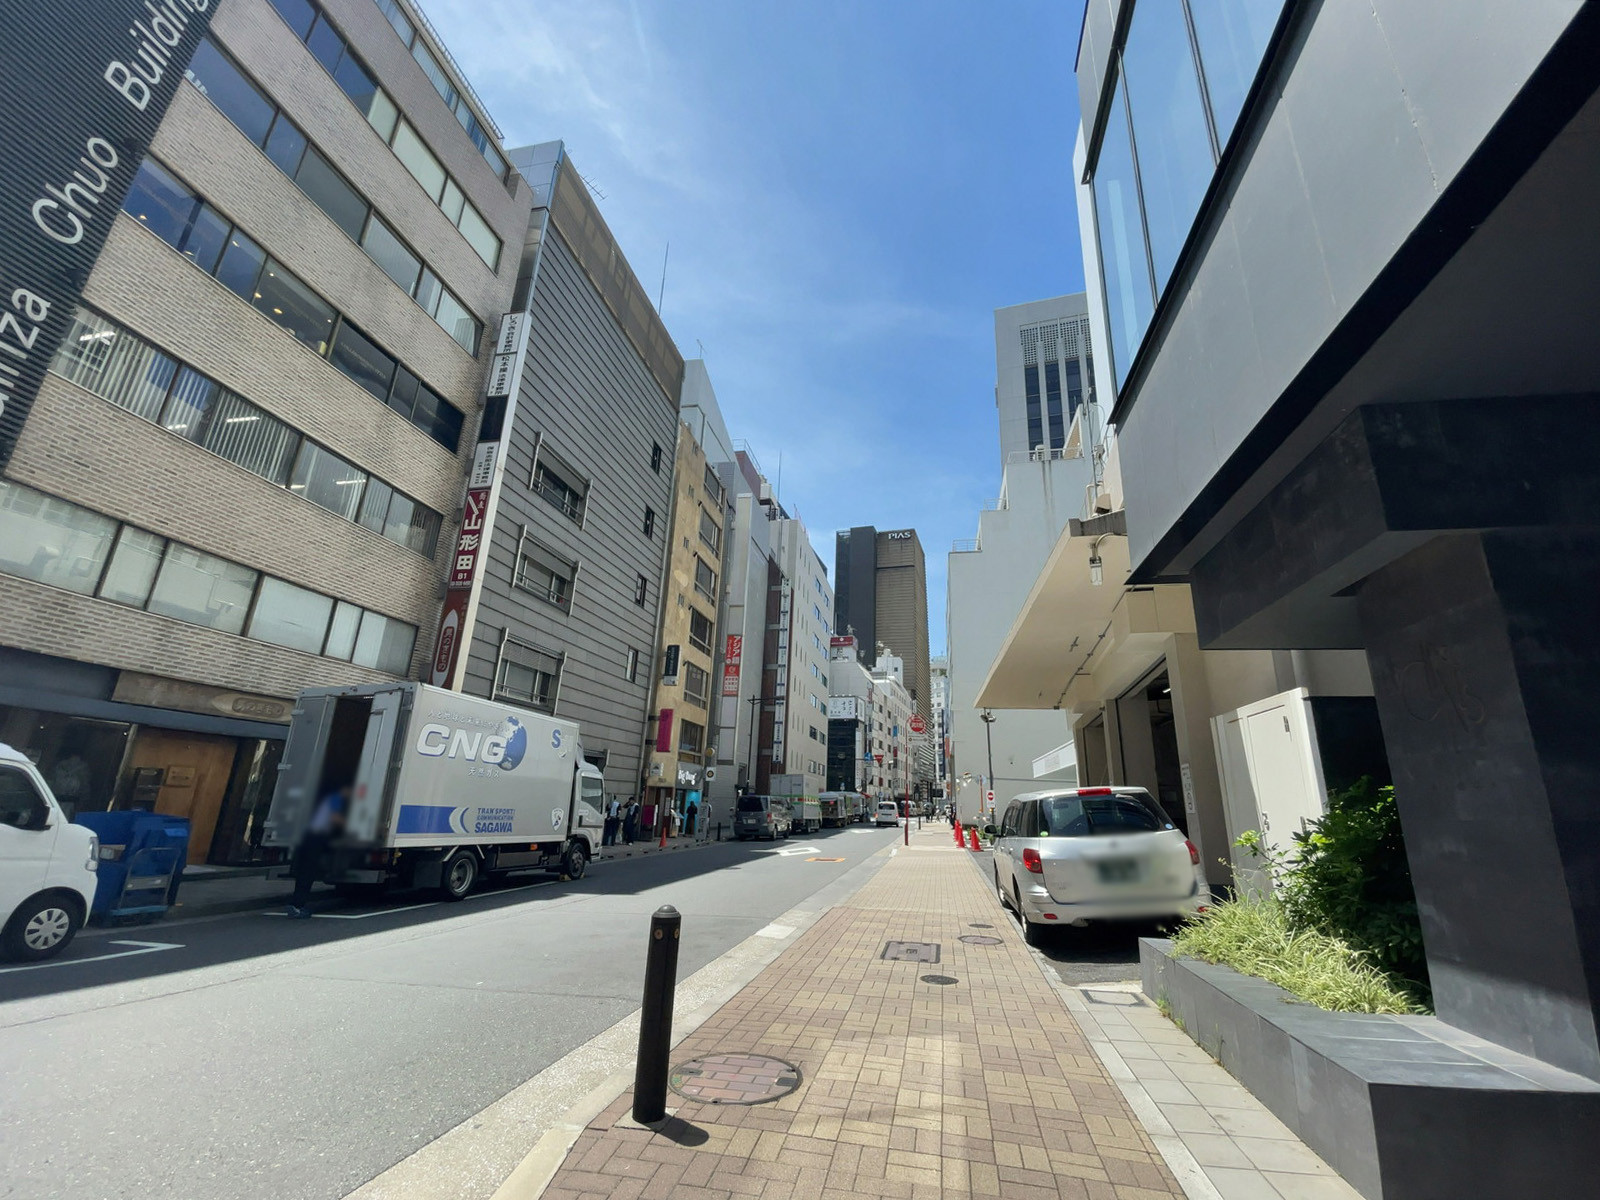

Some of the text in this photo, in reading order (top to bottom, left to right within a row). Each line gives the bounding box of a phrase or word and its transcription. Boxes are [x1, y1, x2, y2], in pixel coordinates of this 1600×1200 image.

[32, 137, 118, 245] Chuo
[104, 0, 208, 111] Building
[456, 496, 482, 570] 山形田
[888, 531, 911, 540] PIAS
[416, 723, 507, 765] CNG
[474, 821, 513, 834] SAGAWA
